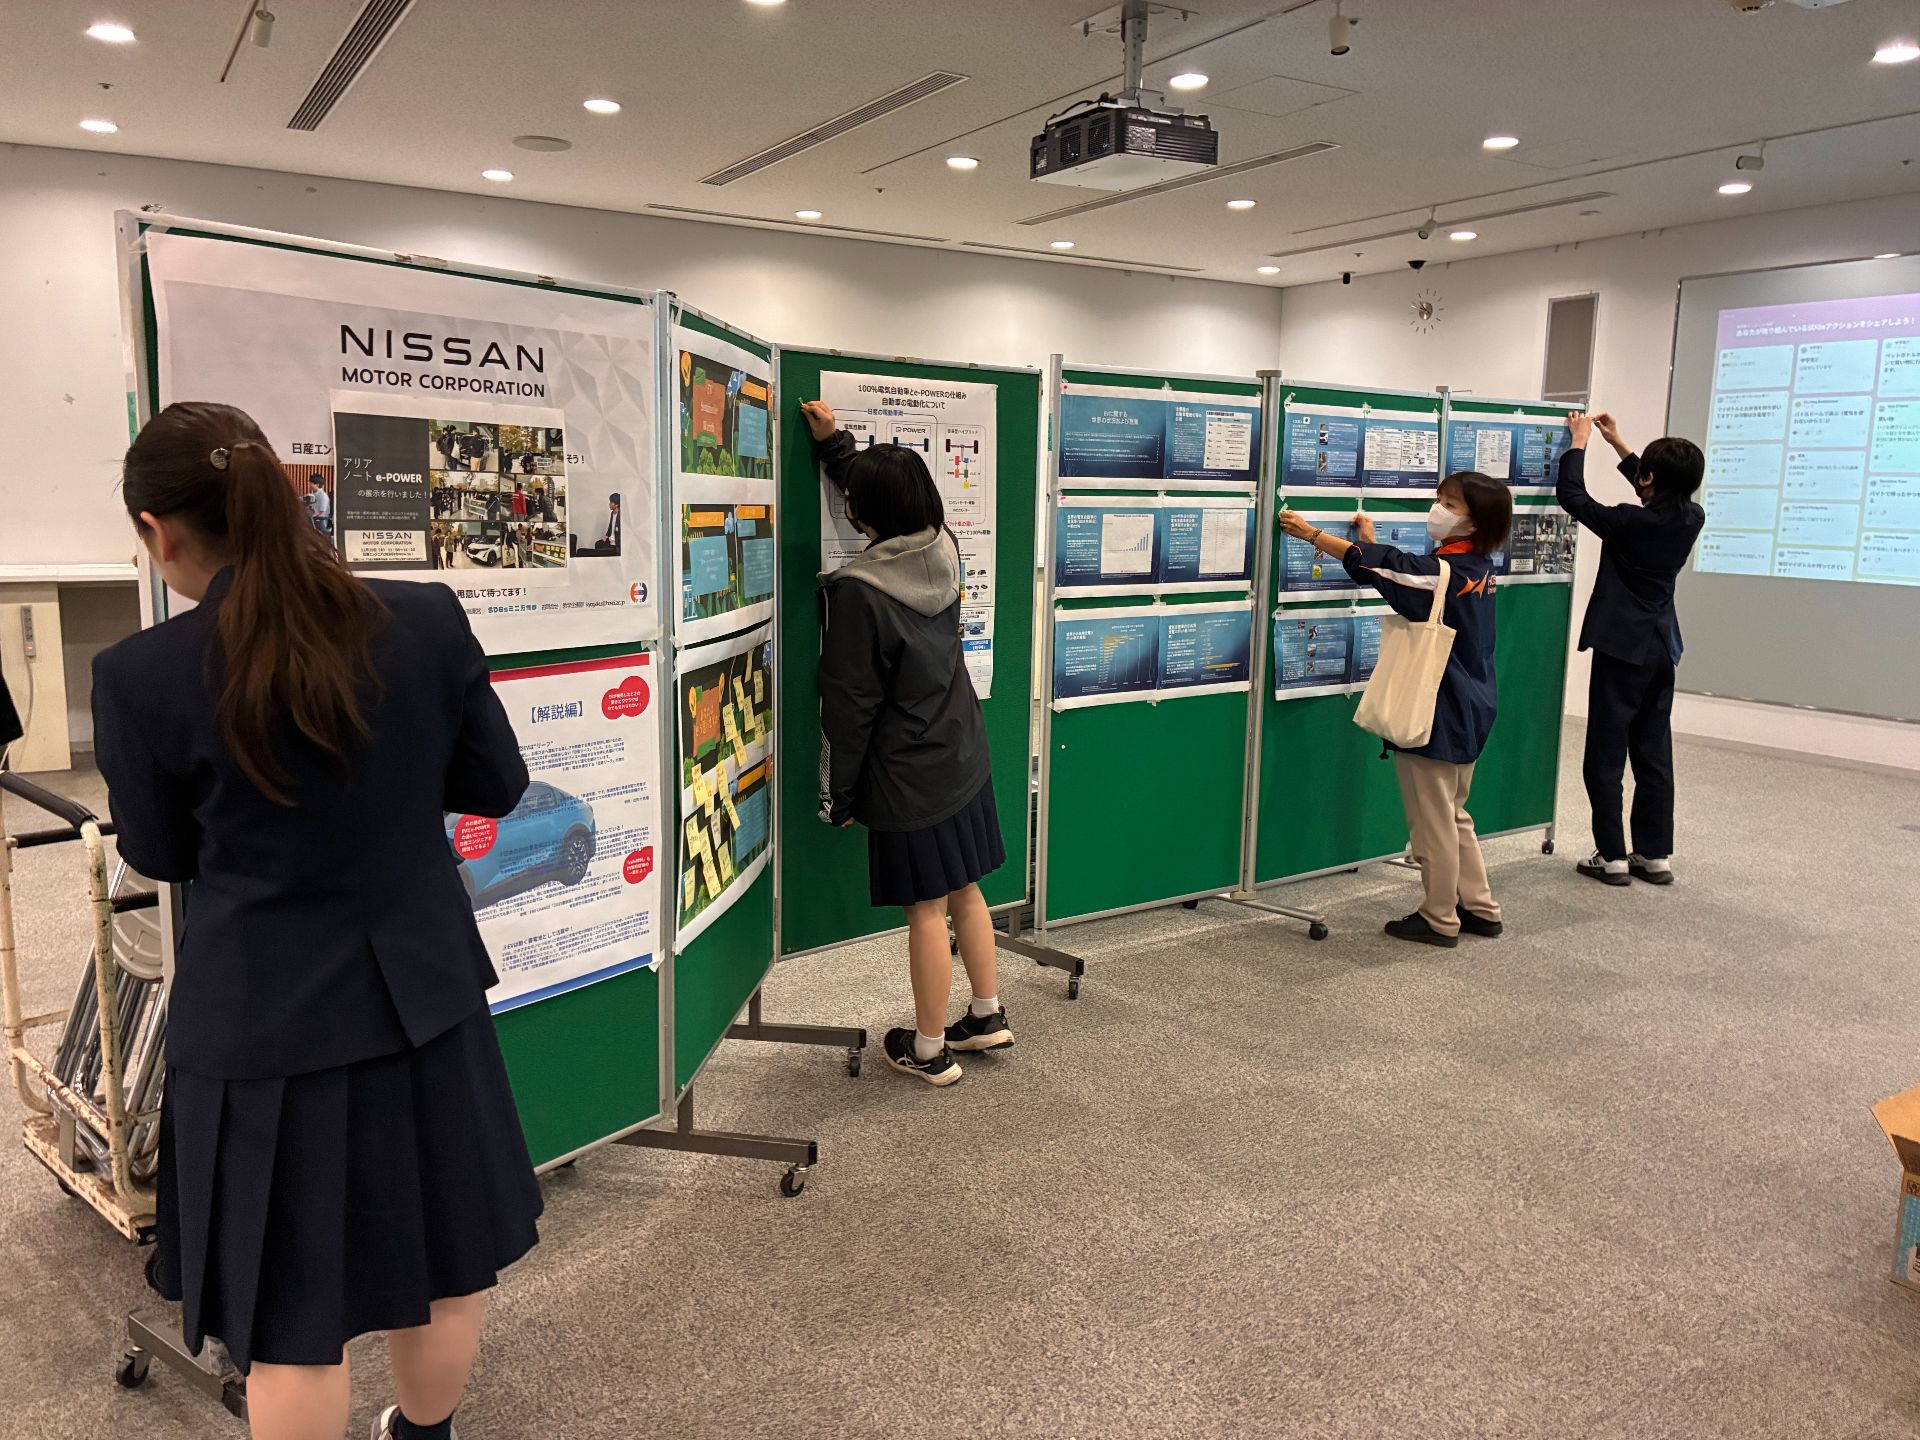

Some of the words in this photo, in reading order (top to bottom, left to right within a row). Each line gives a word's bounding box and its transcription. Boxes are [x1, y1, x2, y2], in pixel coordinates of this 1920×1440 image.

[341, 325, 544, 373] NISSAN
[342, 367, 412, 387] MOTOR
[419, 374, 545, 398] CORPORATION
[881, 397, 946, 410] 自動車の電動化について
[343, 457, 373, 469] アリア
[343, 470, 372, 482] ノート
[375, 472, 423, 484] e-POWER
[357, 489, 428, 499] の展示を行いました！
[362, 532, 412, 540] NISSAN
[531, 700, 583, 724] 【解説編】
